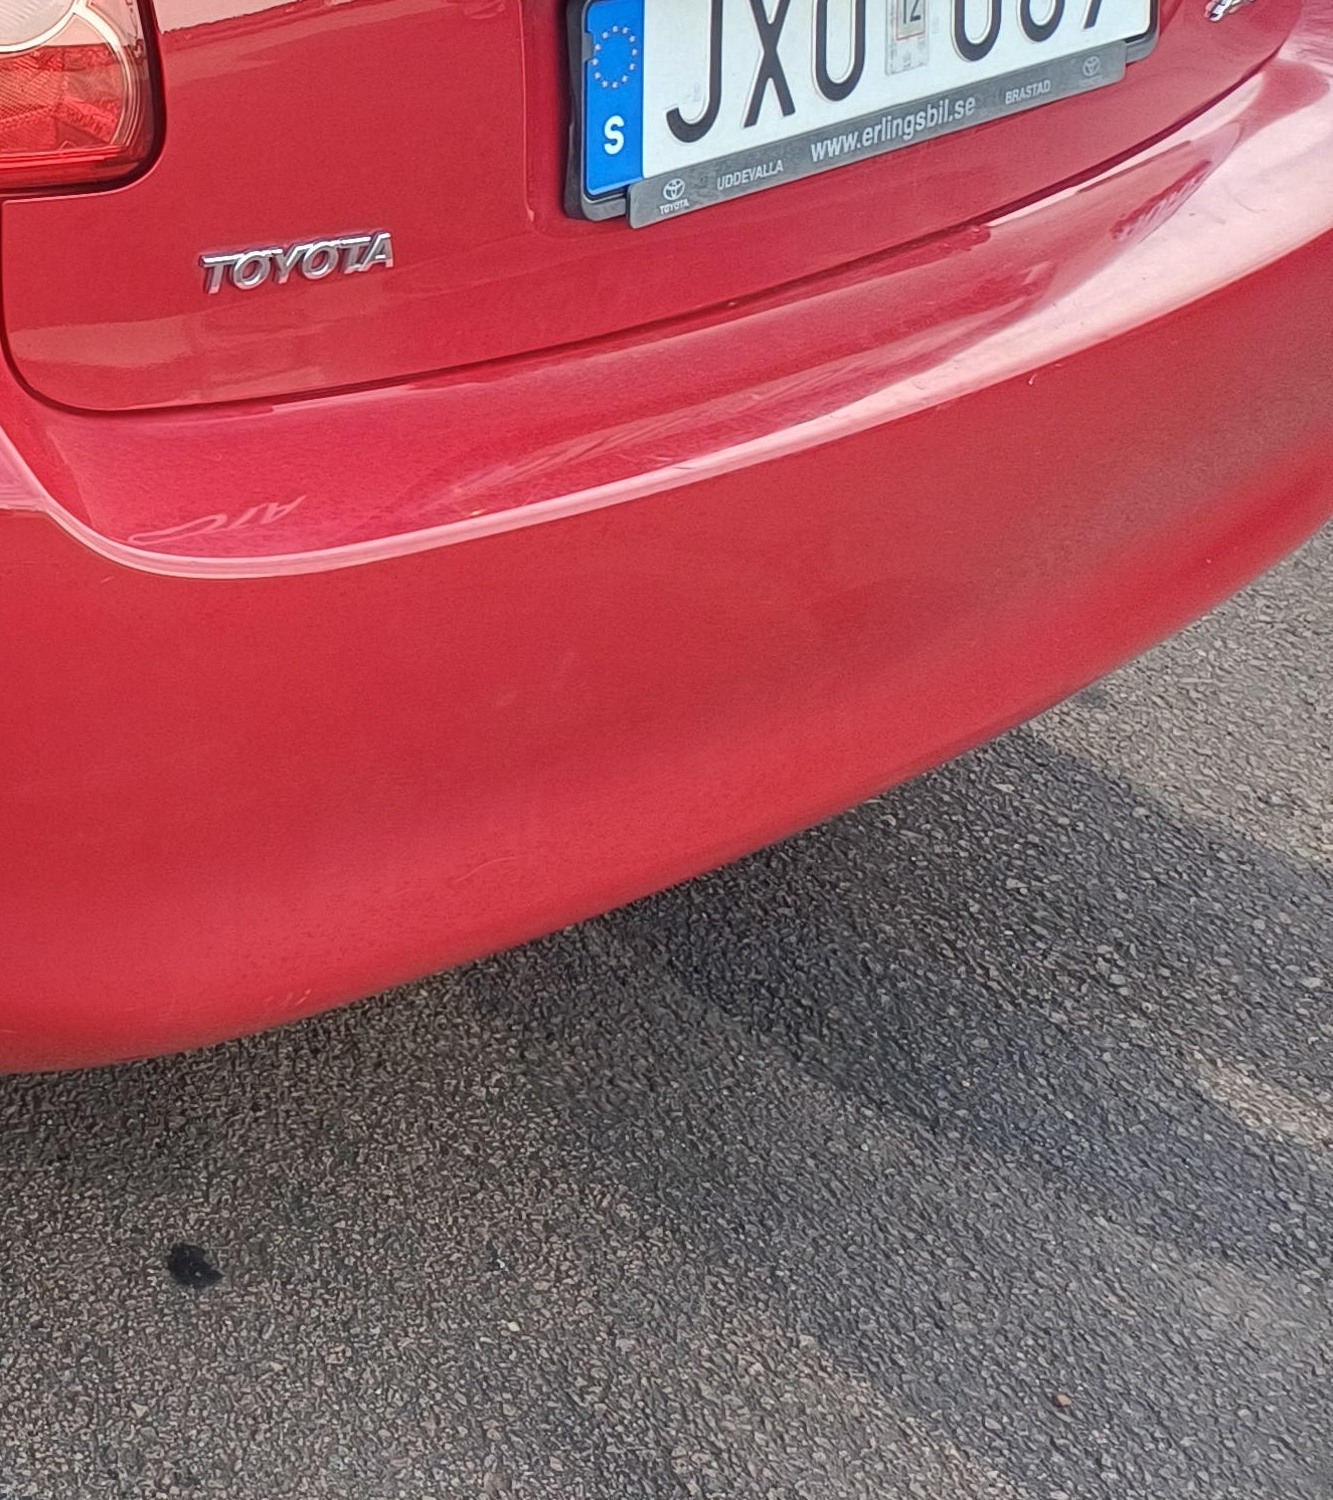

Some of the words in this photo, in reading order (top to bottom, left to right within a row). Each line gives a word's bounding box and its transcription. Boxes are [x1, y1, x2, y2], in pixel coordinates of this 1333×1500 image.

[602, 113, 625, 156] S
[716, 158, 785, 191] UDDEVALLA
[811, 94, 976, 163] www.erlingsbil.se
[1005, 80, 1051, 106] BRASTAD
[658, 198, 690, 215] TOYOTA
[199, 231, 395, 295] TOYOTA
